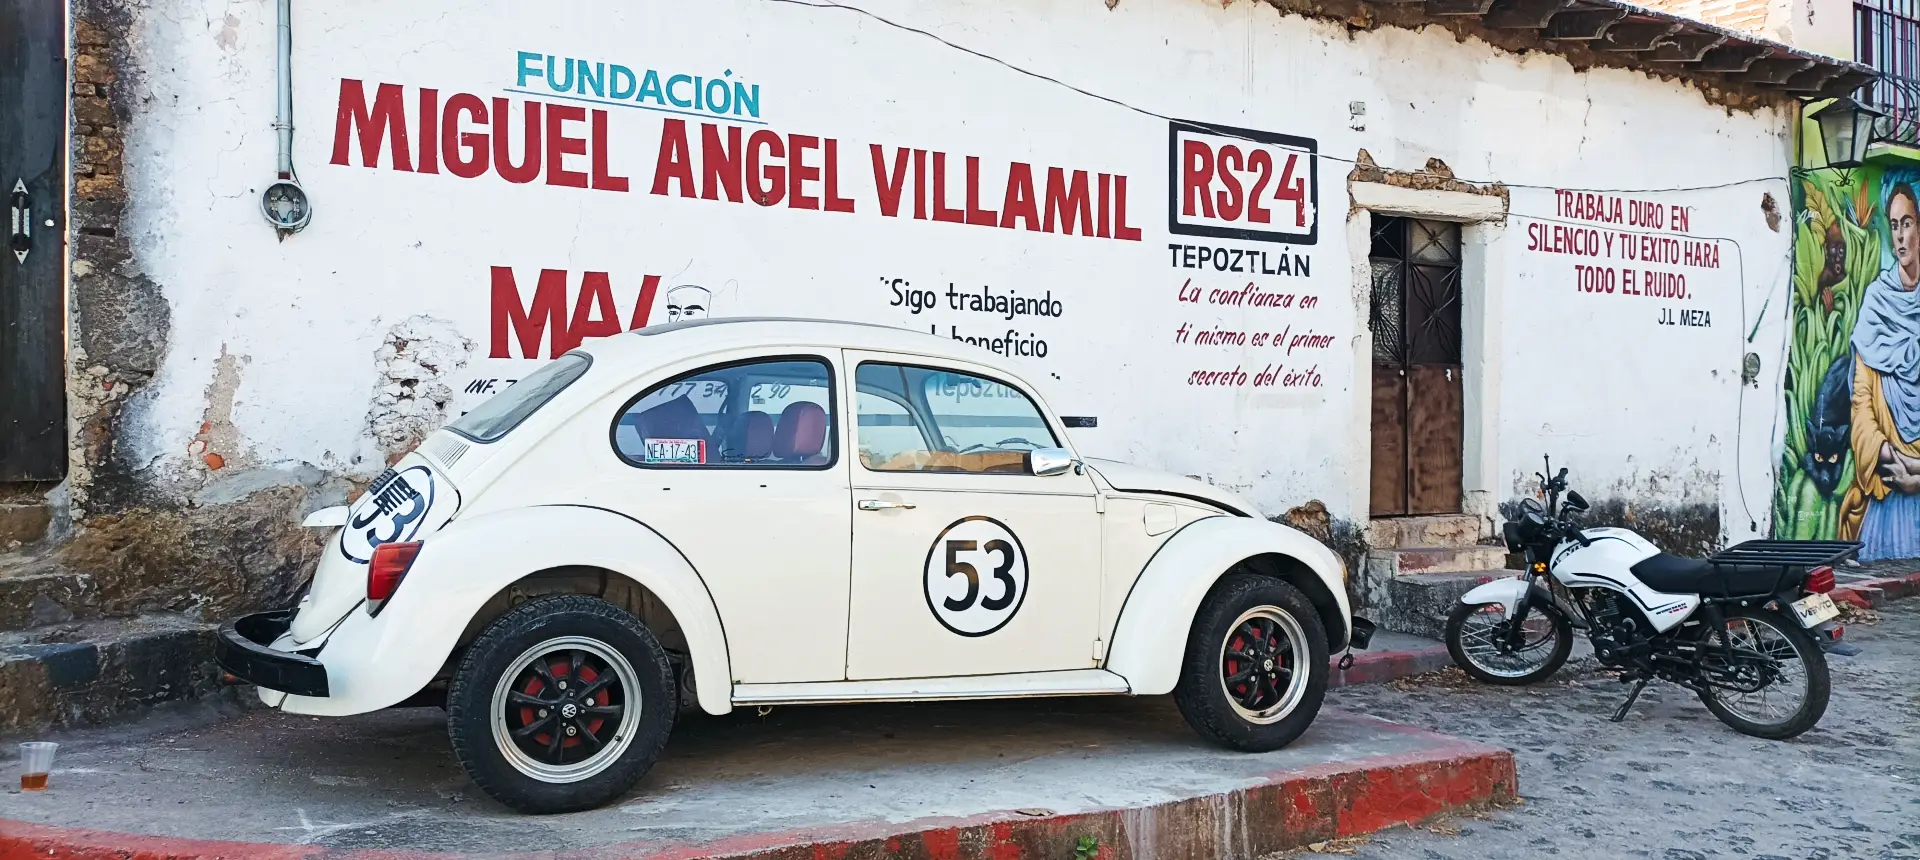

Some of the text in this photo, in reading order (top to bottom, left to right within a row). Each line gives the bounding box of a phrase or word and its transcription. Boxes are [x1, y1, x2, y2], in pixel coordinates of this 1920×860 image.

[517, 50, 760, 118] FUNDACIÓN
[330, 78, 1142, 241] MIGUEL ANGEL VILLAMIL
[1183, 139, 1305, 227] RS24
[1555, 189, 1689, 232] TRABAJA DURO EN
[1168, 243, 1311, 277] TEPOZTLÁN
[1528, 223, 1599, 257] SILENCIO
[1604, 231, 1614, 257] Y
[1619, 233, 1637, 260] TU
[1684, 239, 1720, 269] HARÁ
[1177, 277, 1319, 310] La confianza en
[1575, 265, 1615, 293] TODO
[1622, 269, 1640, 295] EL
[946, 283, 1063, 320] trabajando
[1680, 309, 1711, 327] MEZA
[1175, 321, 1335, 356] ti mismo es el primer
[464, 378, 498, 395] INF.
[1187, 364, 1248, 388] secreto
[1253, 362, 1283, 388] del
[942, 538, 1017, 612] 53
